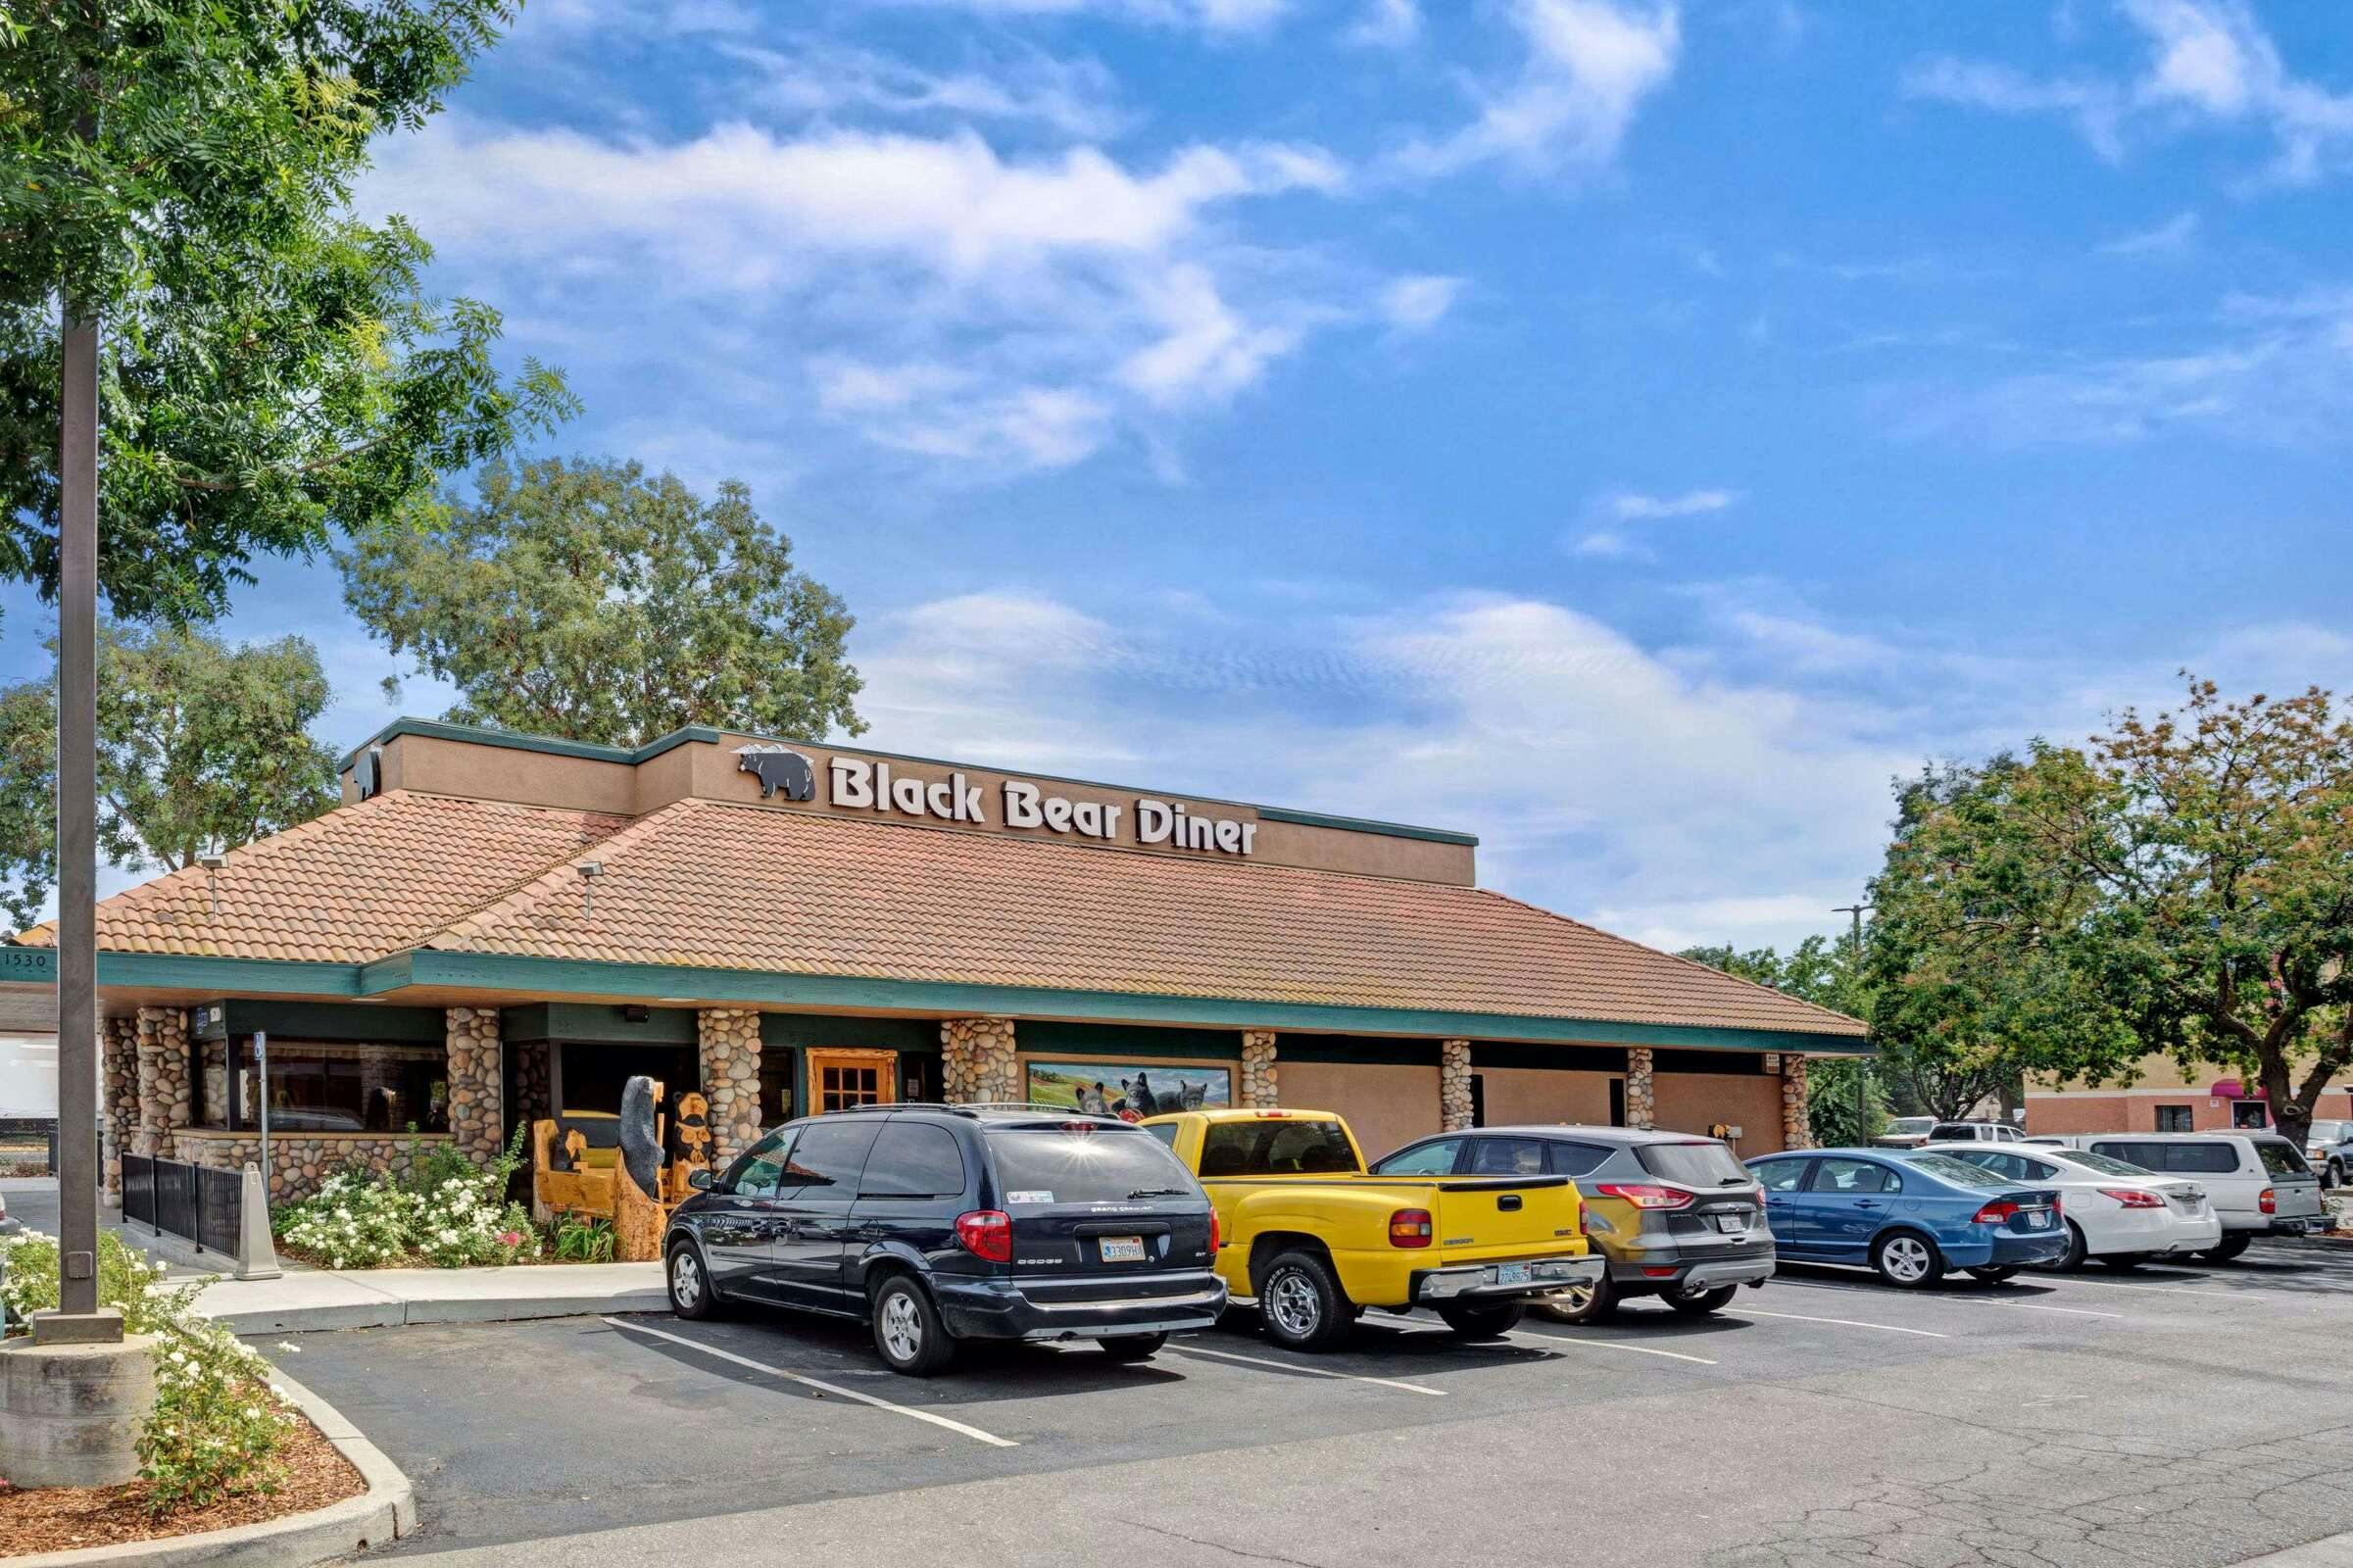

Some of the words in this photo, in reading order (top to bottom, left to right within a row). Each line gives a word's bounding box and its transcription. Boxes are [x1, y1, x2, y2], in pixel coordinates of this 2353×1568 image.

[828, 757, 986, 823] Black
[1002, 780, 1122, 839] Bear
[1135, 799, 1257, 856] Diner
[5, 954, 46, 967] 1530
